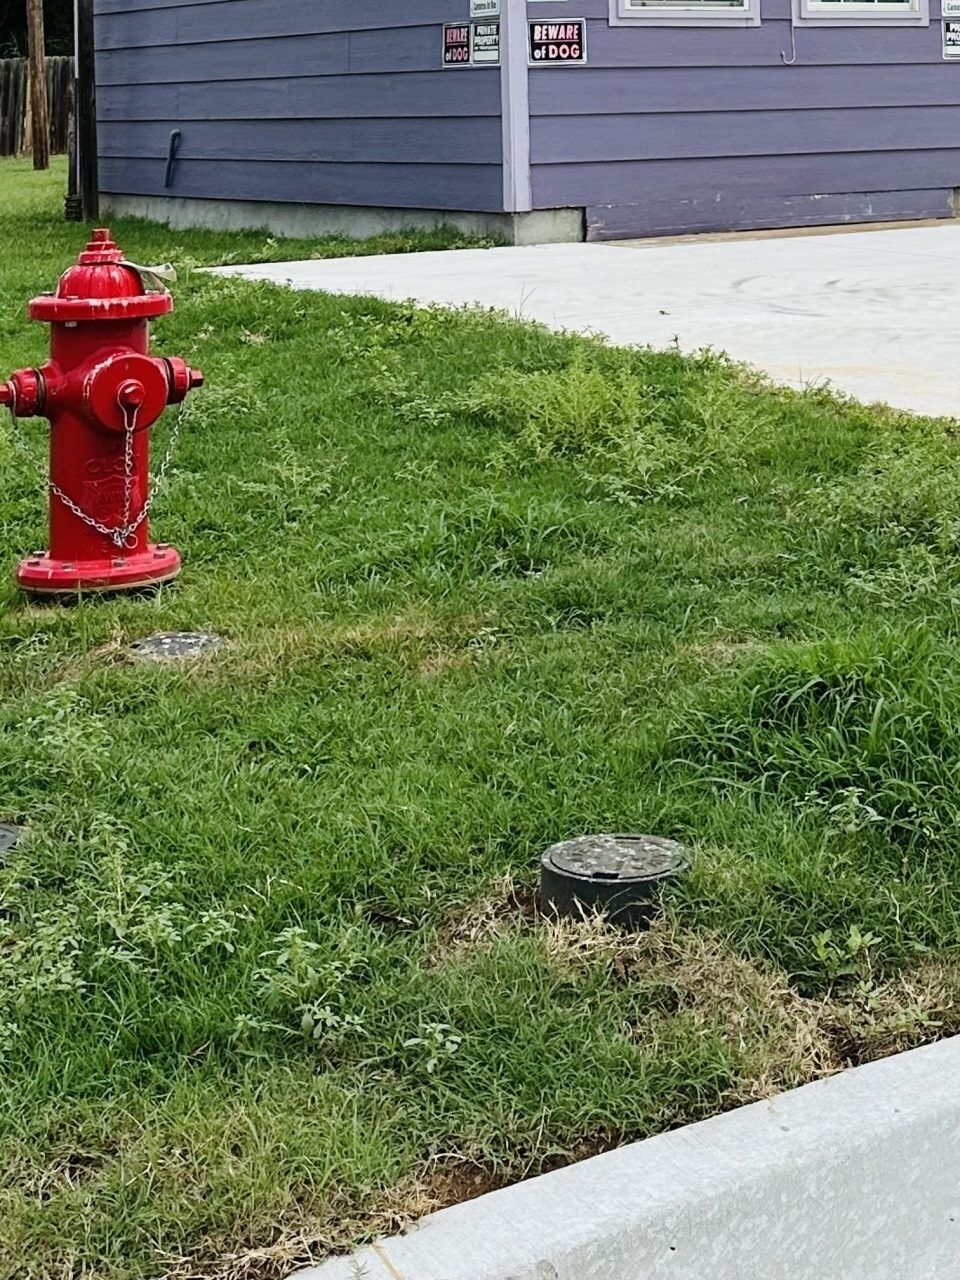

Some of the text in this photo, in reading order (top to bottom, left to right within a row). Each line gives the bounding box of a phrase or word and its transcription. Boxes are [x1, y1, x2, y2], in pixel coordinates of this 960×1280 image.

[446, 27, 468, 43] BEWARE
[533, 25, 579, 40] BEWARE
[445, 46, 468, 62] of DOG
[533, 43, 580, 59] of DOG
